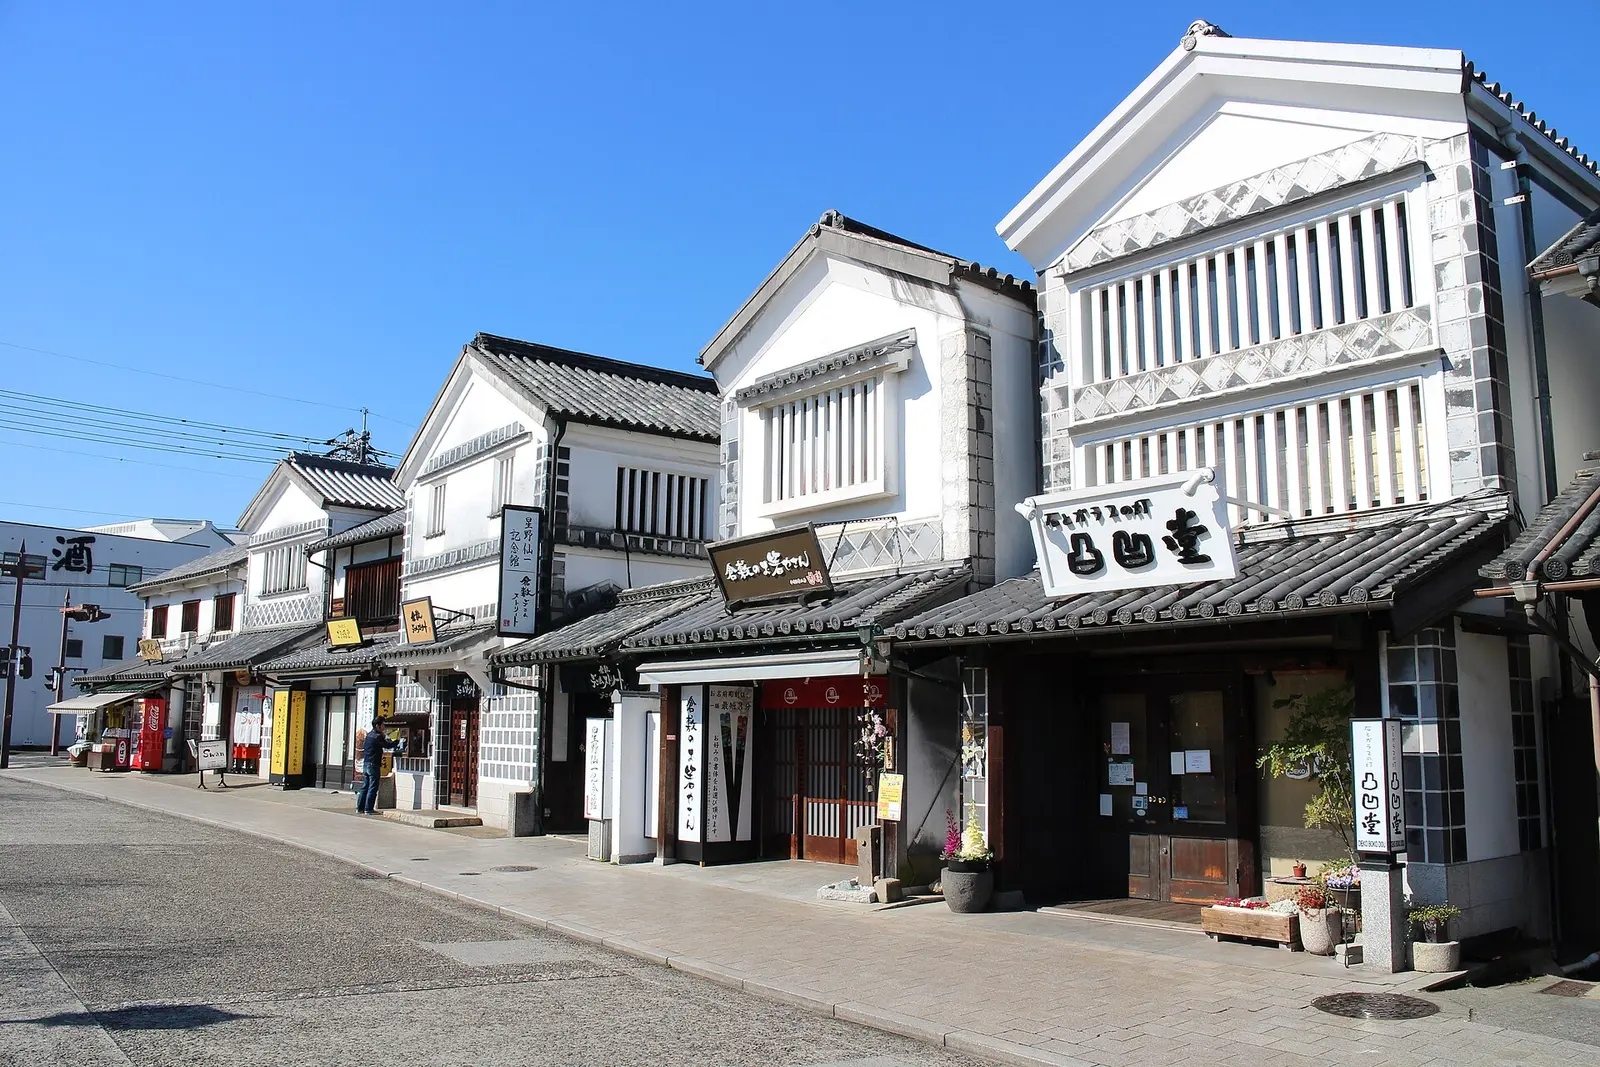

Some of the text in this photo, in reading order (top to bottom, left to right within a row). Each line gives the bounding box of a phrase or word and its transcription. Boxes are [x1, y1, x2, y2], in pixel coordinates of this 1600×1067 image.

[52, 535, 96, 574] 酒
[509, 529, 521, 567] 記念館
[523, 517, 533, 561] 星野仙一
[1067, 507, 1212, 575] 凸凹堂
[203, 749, 225, 758] Swan
[1361, 772, 1381, 835] 凸凹堂
[1390, 771, 1402, 835] 凸凹堂
